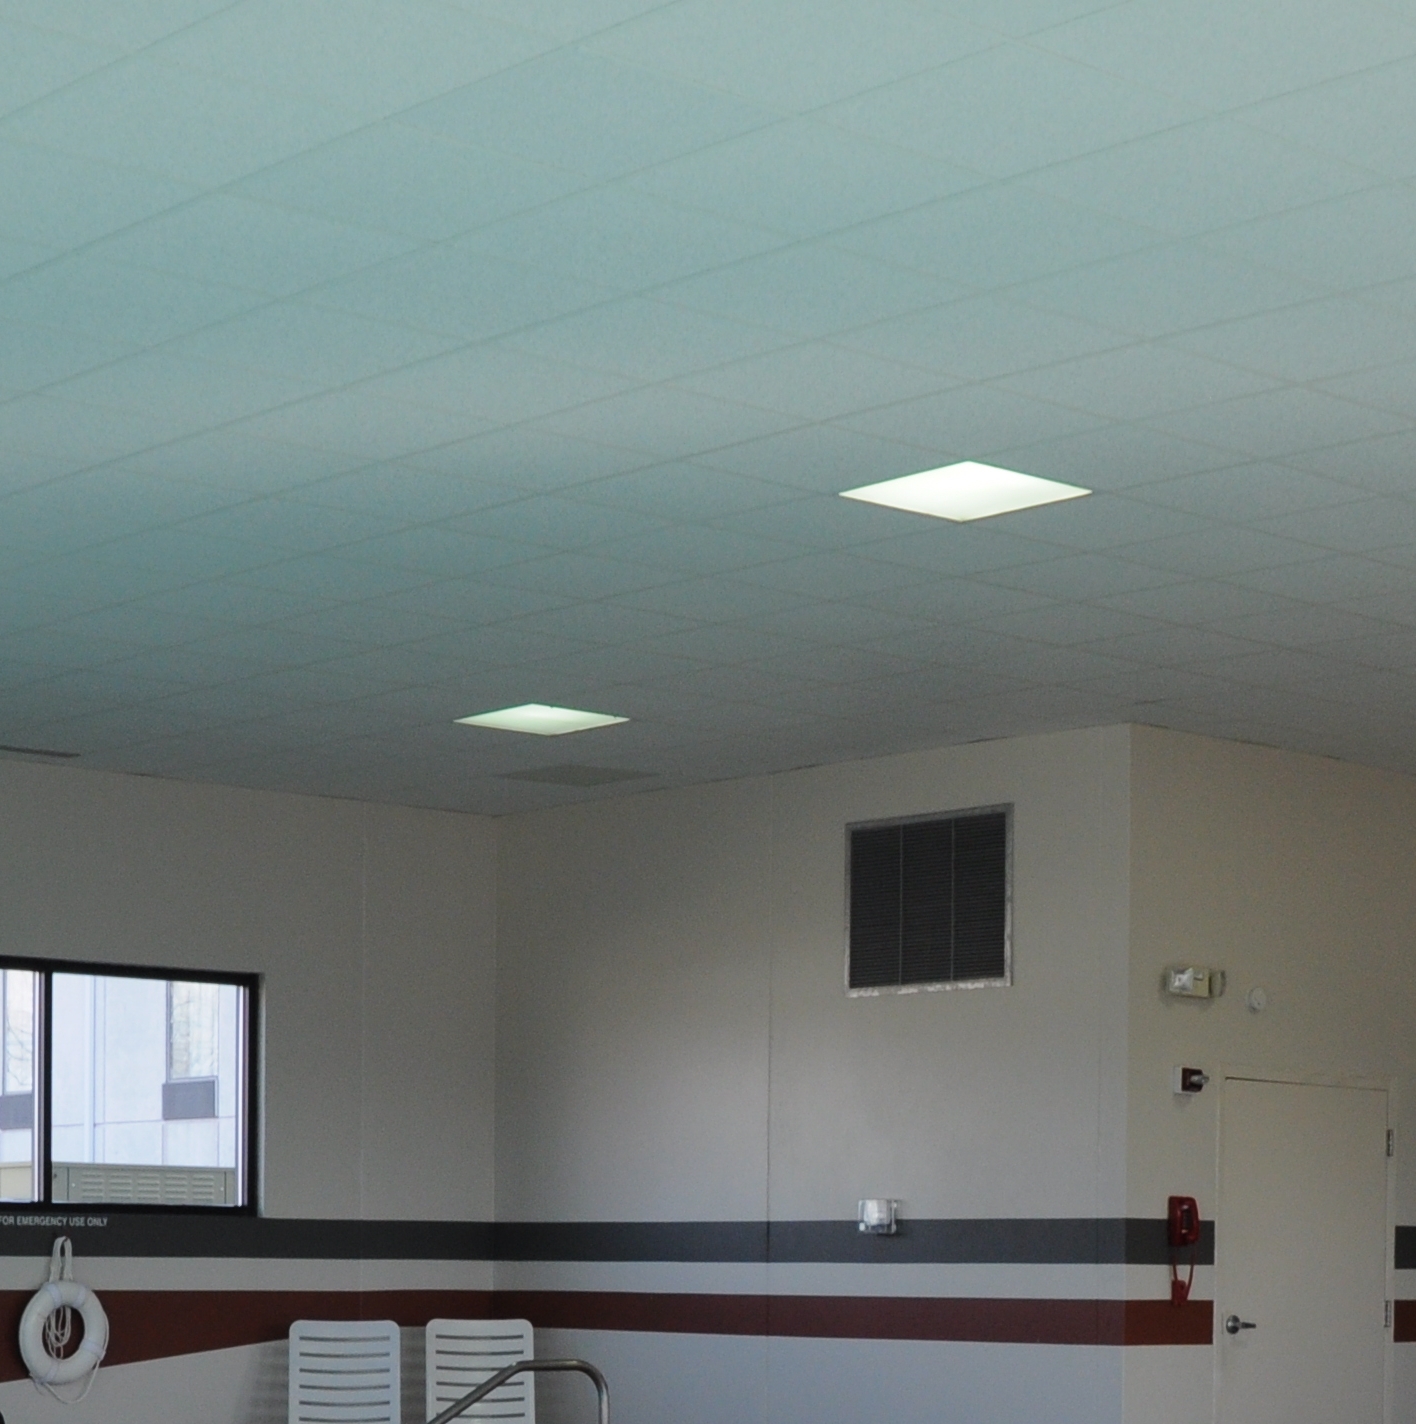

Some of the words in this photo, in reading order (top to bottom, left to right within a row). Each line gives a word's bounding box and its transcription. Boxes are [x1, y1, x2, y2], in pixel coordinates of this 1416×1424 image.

[16, 1215, 67, 1227] EMERGENCY
[69, 1217, 85, 1227] USE
[86, 1217, 108, 1227] ONLY
